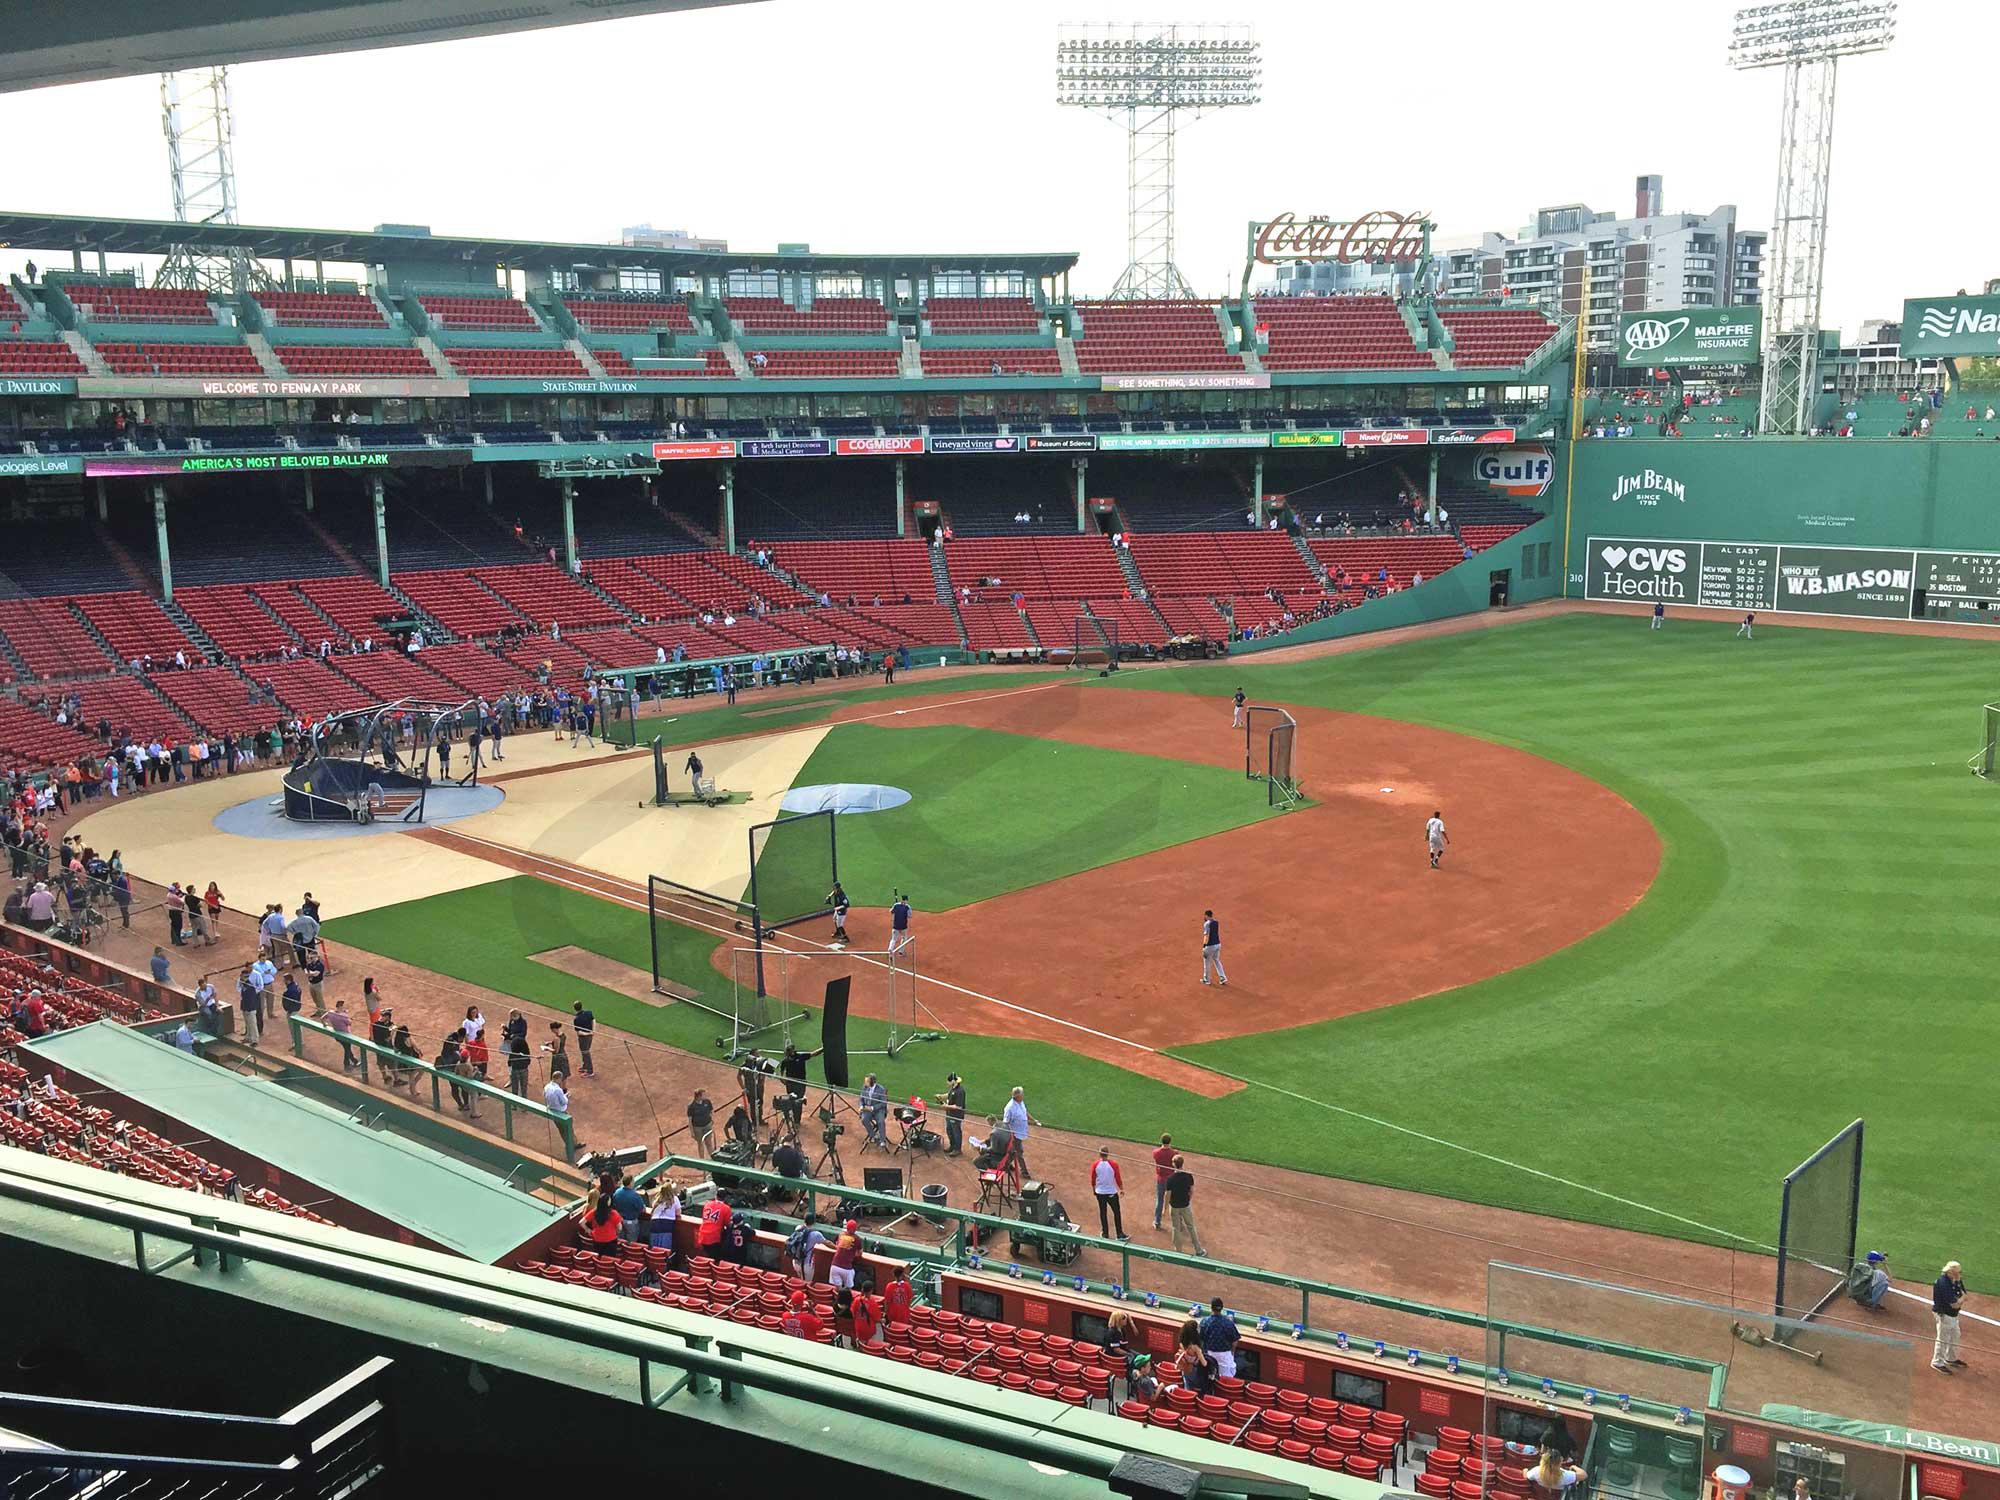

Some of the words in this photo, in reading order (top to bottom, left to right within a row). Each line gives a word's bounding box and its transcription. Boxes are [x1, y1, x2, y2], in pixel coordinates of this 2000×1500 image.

[1255, 210, 1430, 265] Coca-Cola
[1631, 322, 1664, 348] AAA
[1695, 324, 1754, 337] MAPFRE
[1697, 339, 1749, 349] INSURANCE
[8, 381, 61, 393] PAVILION
[542, 381, 567, 391] STATE
[568, 381, 597, 391] STREET
[599, 381, 637, 391] PAVILION
[1118, 380, 1134, 388] SEE
[1138, 378, 1186, 388] SOMETHING,
[1188, 378, 1205, 387] SAY
[1209, 377, 1254, 387] SOMETHING
[203, 383, 259, 394] WELCOME
[263, 383, 278, 393] TO
[281, 382, 328, 394] FENWAY
[332, 382, 362, 394] PARK
[1438, 433, 1475, 442] Safelite
[849, 439, 911, 450] COGMEDIX
[934, 439, 970, 449] vineyard
[970, 439, 993, 447] vines
[1070, 439, 1091, 447] Science
[41, 459, 68, 470] Level
[182, 457, 243, 470] AMERICA'S
[246, 457, 277, 468] MOST
[281, 456, 330, 467] BELOVED
[333, 454, 389, 466] BALLPARK
[1480, 457, 1549, 480] Gulf
[1612, 474, 1641, 501] JIM
[1644, 469, 1686, 502] BEAM
[1629, 547, 1687, 573] CVS
[1703, 566, 1716, 574] NEW
[1782, 567, 1801, 575] WHO
[1803, 568, 1820, 576] BUT
[1931, 564, 1937, 572] P
[1569, 574, 1583, 583] 310
[1703, 574, 1727, 582] BOSTON
[1736, 575, 1745, 583] 50
[1946, 574, 1961, 582] SEA
[1602, 571, 1685, 598] Health
[1702, 582, 1731, 590] TORONTO
[1736, 583, 1744, 591] 34
[1938, 584, 1967, 592] BOSTON
[1702, 590, 1720, 598] TAMPA
[1857, 593, 1883, 601] SINCE
[1885, 594, 1905, 602] 1898
[1701, 598, 1733, 606] BALTIMORE
[1938, 600, 1952, 608] BAT
[1958, 602, 1979, 610] BALL
[703, 1208, 720, 1223] 34
